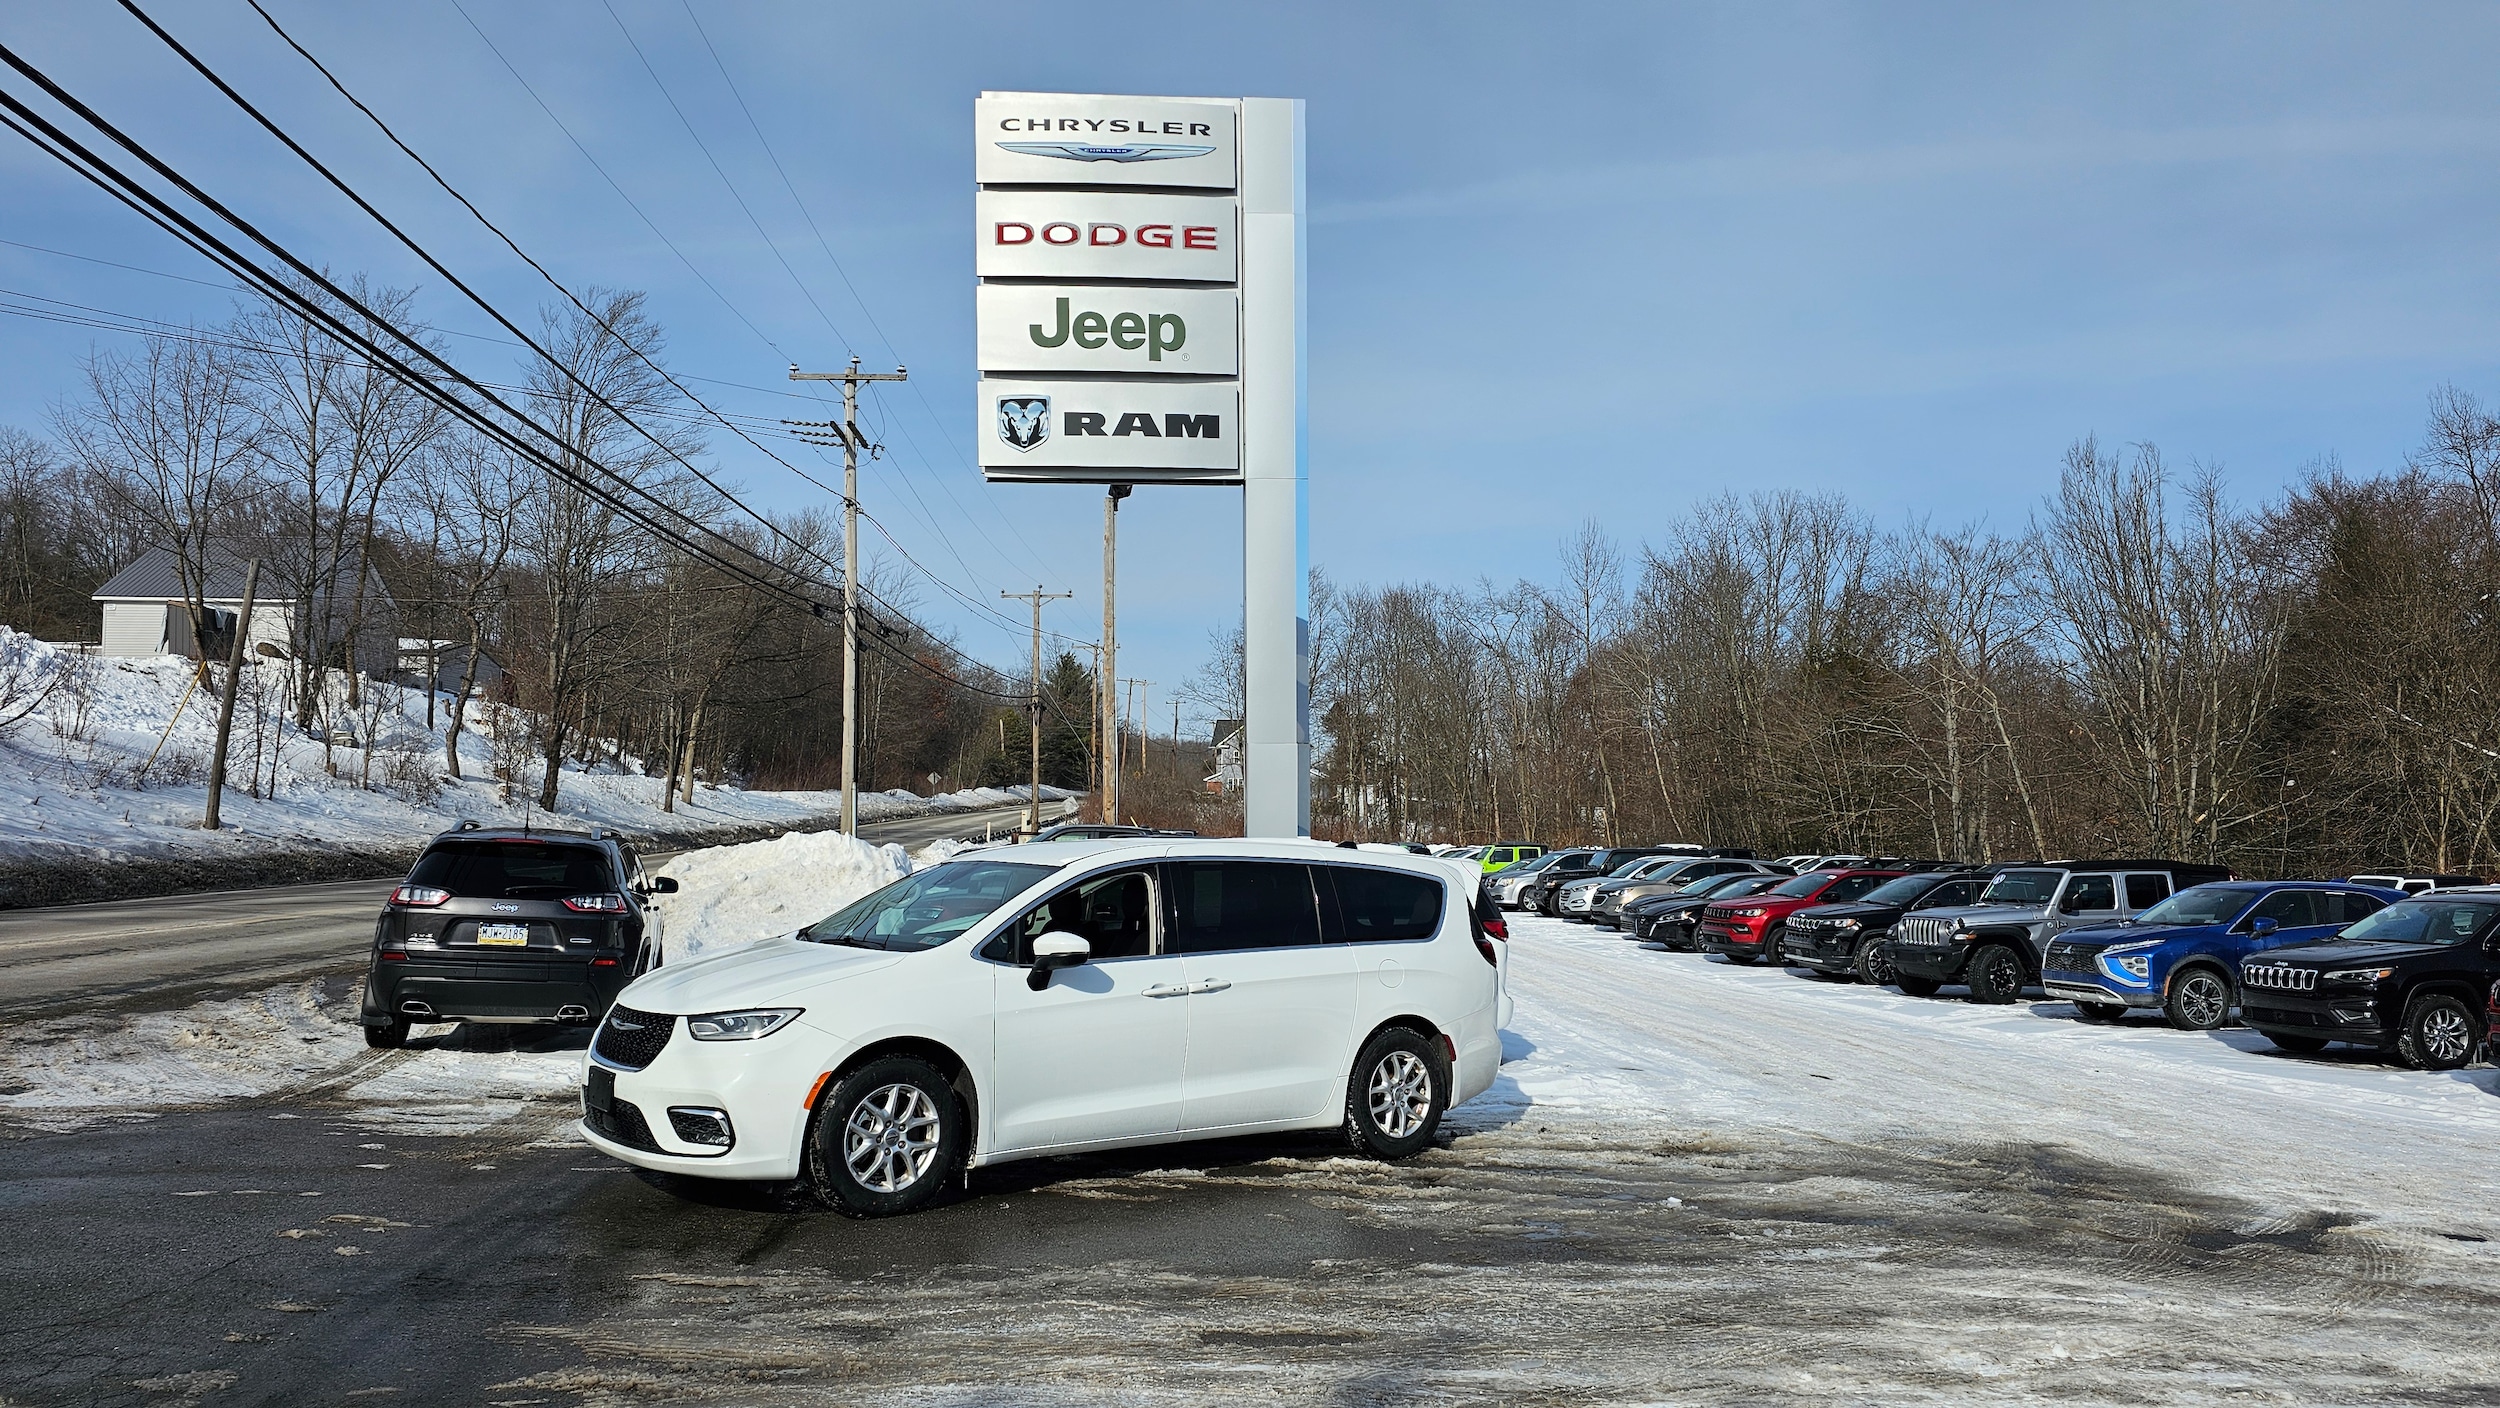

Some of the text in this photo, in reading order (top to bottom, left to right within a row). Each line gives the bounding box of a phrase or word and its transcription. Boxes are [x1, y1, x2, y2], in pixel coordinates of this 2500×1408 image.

[1000, 118, 1212, 137] CHRYSLER
[995, 221, 1219, 251] DODGE
[1029, 297, 1187, 362] Jeep
[1064, 411, 1221, 440] RAM
[491, 902, 519, 913] Jeep
